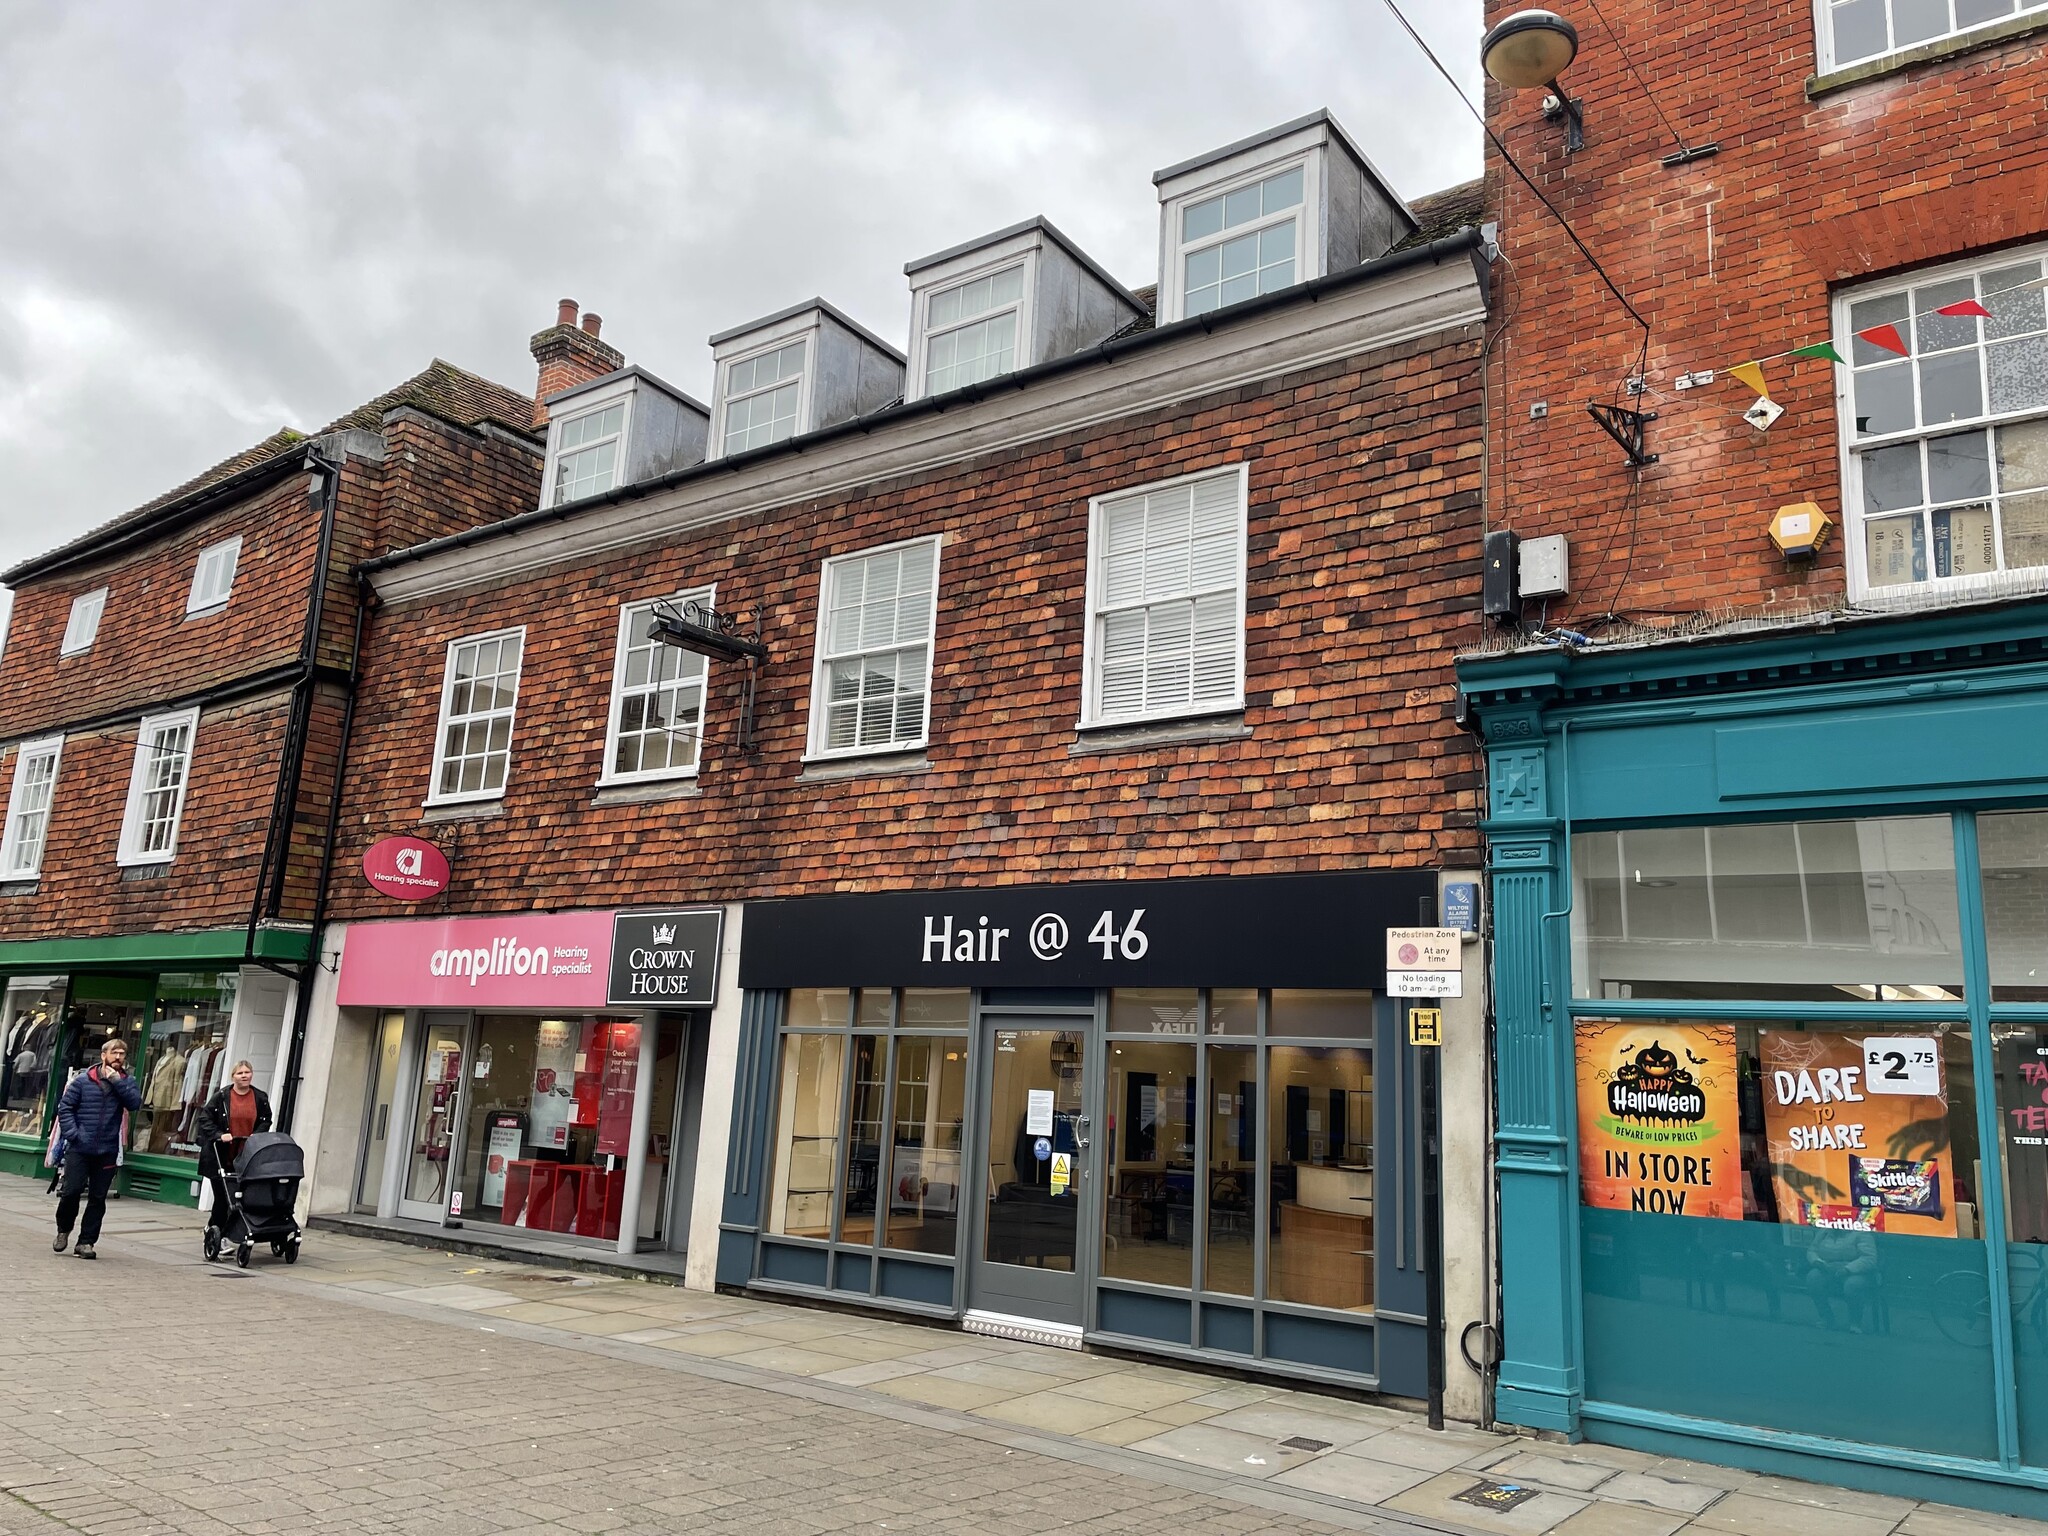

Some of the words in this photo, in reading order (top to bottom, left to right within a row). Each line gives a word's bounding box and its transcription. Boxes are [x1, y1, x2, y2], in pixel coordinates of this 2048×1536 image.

[1875, 531, 1884, 541] 18
[1983, 525, 1992, 564] 400014171
[1493, 559, 1500, 568] 4
[374, 872, 405, 884] Hearing
[406, 877, 439, 887] specialist
[922, 915, 1010, 962] Hair
[1029, 912, 1069, 961] @
[1087, 909, 1149, 960] 46
[1391, 930, 1434, 938] Pedestrian
[1436, 930, 1456, 938] Zone
[553, 945, 588, 960] Hearing
[629, 947, 696, 969] CROWN
[430, 936, 549, 987] amplifon
[551, 962, 592, 977] specialist
[629, 972, 688, 994] HOUSE
[1402, 974, 1414, 982] No
[1416, 974, 1446, 983] loading
[1398, 984, 1408, 992] 10
[1638, 1078, 1674, 1092] HAPPY
[1774, 1066, 1864, 1105] DARE
[1612, 1085, 1700, 1113] Halloween
[1813, 1106, 1834, 1124] TO
[1615, 1126, 1644, 1140] BEWARE
[1654, 1132, 1670, 1142] LOW
[1671, 1131, 1698, 1142] PRICES
[1788, 1124, 1866, 1150] SHARE
[2013, 1136, 2042, 1145] THIS
[1605, 1150, 1629, 1178] IN
[1638, 1152, 1712, 1186] STORE
[1867, 1171, 1925, 1189] Skittles
[1631, 1187, 1686, 1216] NOW
[1815, 1217, 1872, 1232] Skittles
